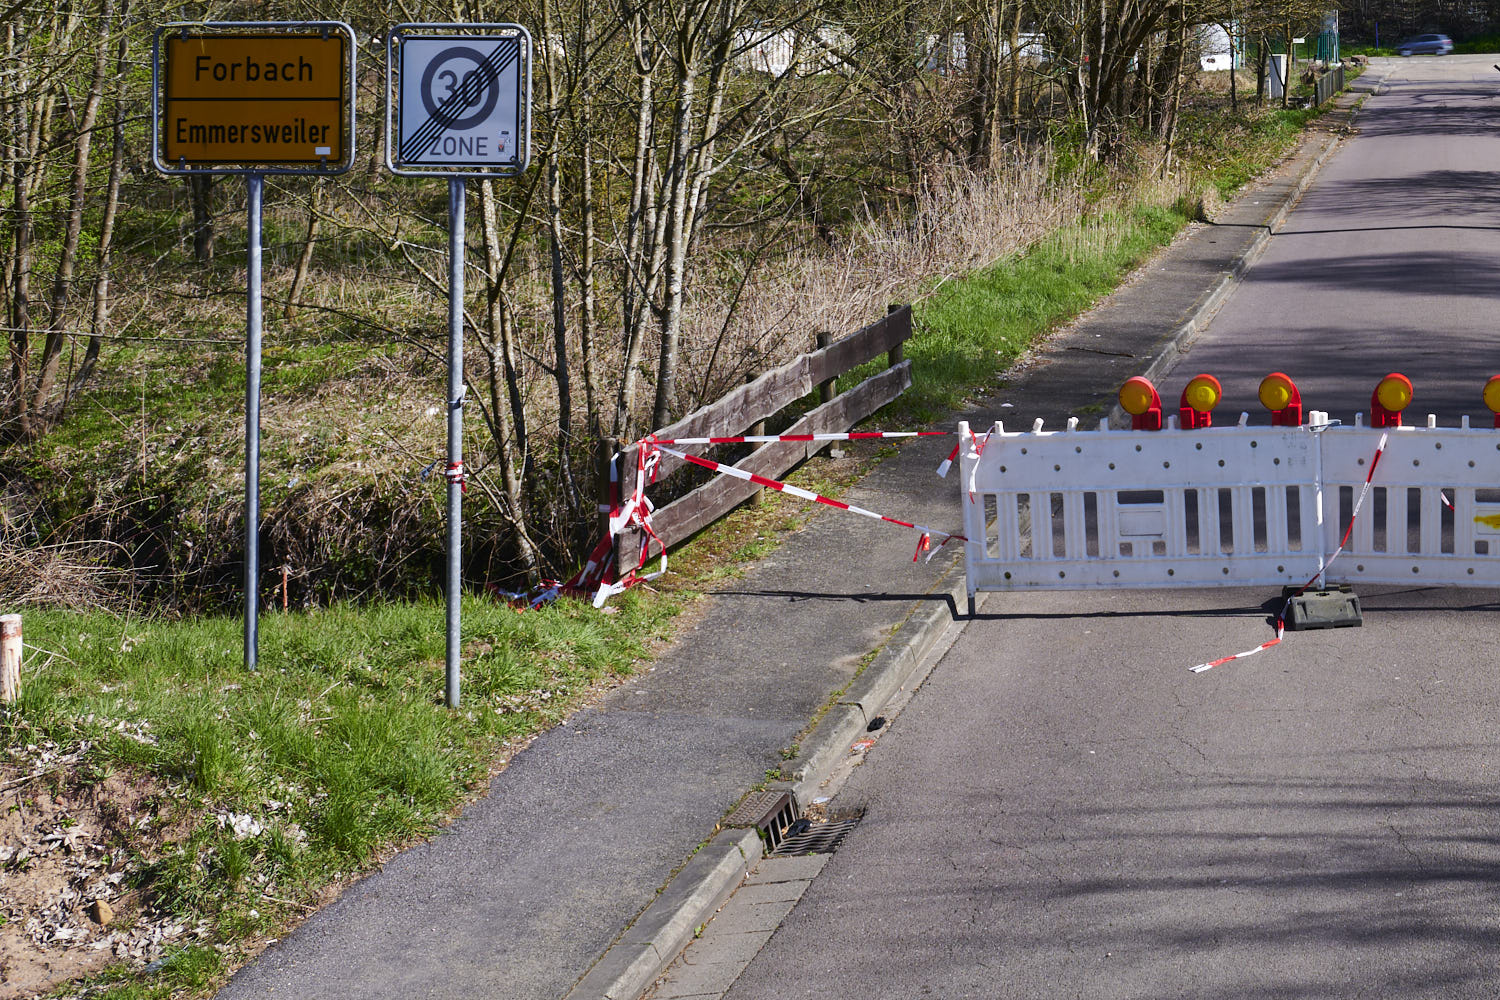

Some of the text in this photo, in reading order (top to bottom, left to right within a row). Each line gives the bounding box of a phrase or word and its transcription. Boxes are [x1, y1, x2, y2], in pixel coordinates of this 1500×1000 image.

[194, 55, 313, 82] Forbach
[437, 69, 481, 107] 30
[176, 117, 330, 147] Emmersweiler
[430, 136, 489, 157] ZONE
